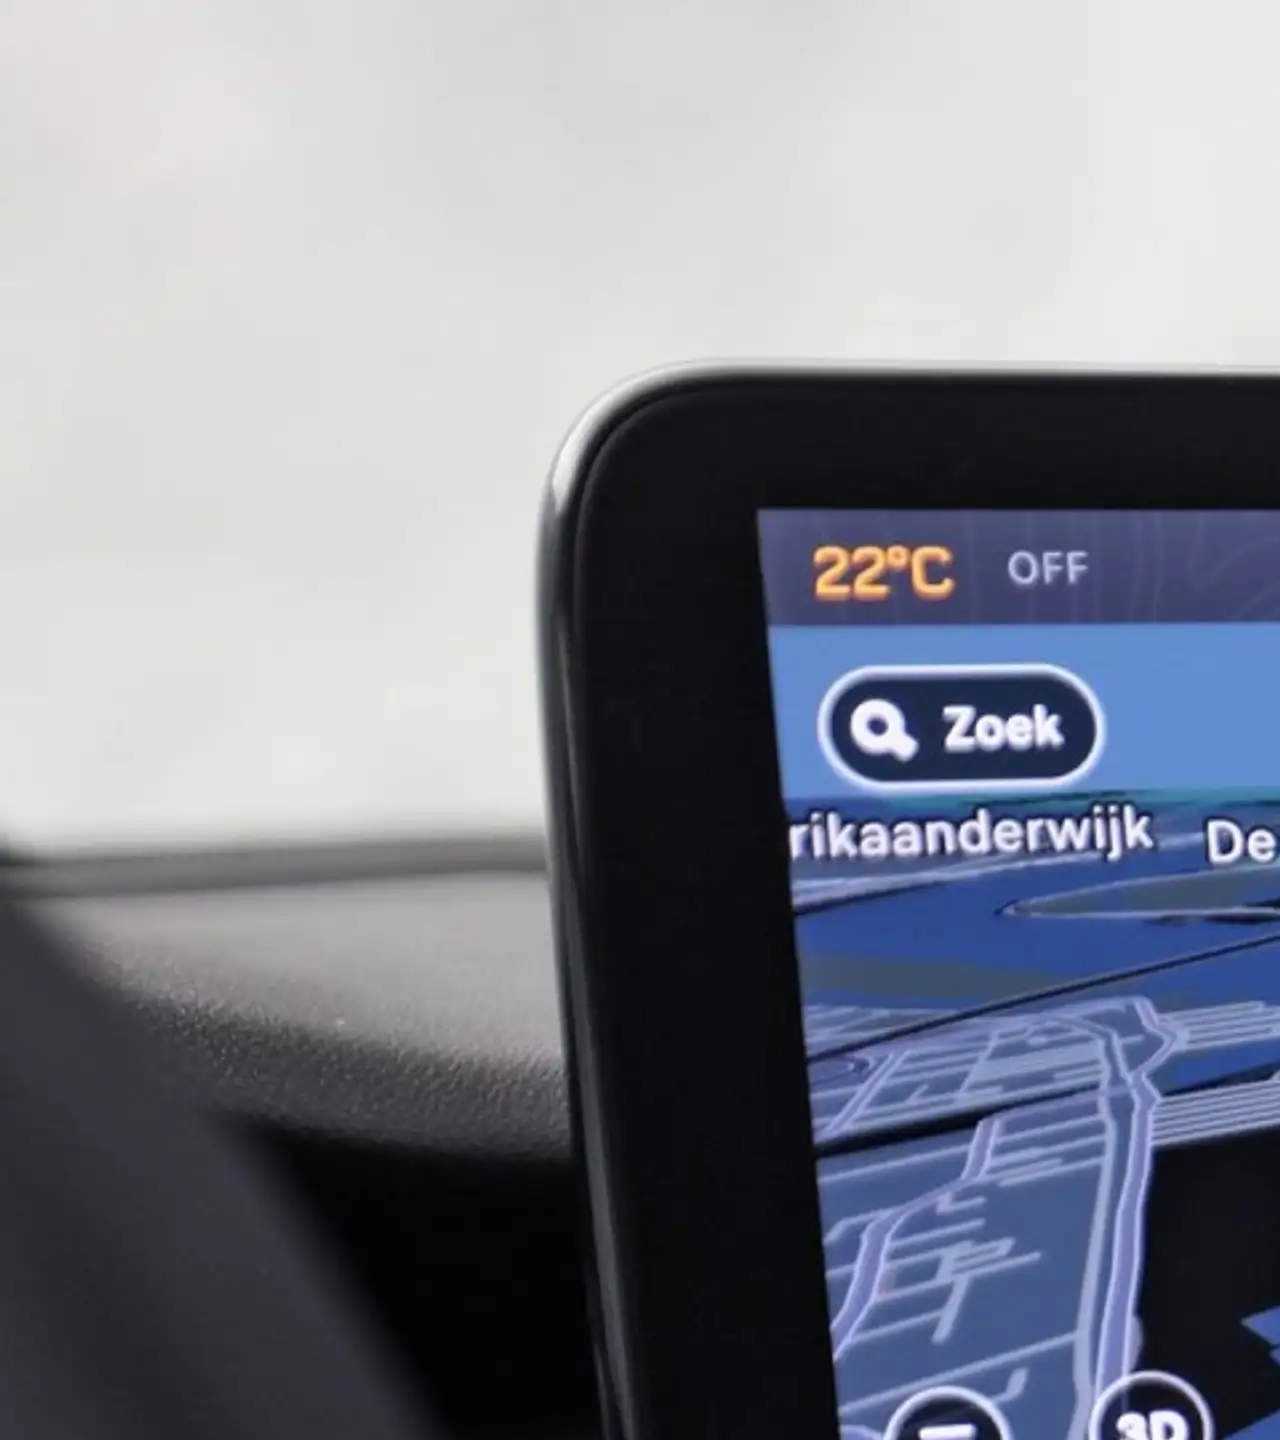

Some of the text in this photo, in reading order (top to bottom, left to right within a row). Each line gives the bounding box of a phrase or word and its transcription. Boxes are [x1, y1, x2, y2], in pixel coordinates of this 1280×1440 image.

[1007, 550, 1090, 587] OFF
[942, 702, 1066, 754] Zoek
[789, 803, 1155, 862] rikaanderwijk
[1206, 818, 1277, 865] De
